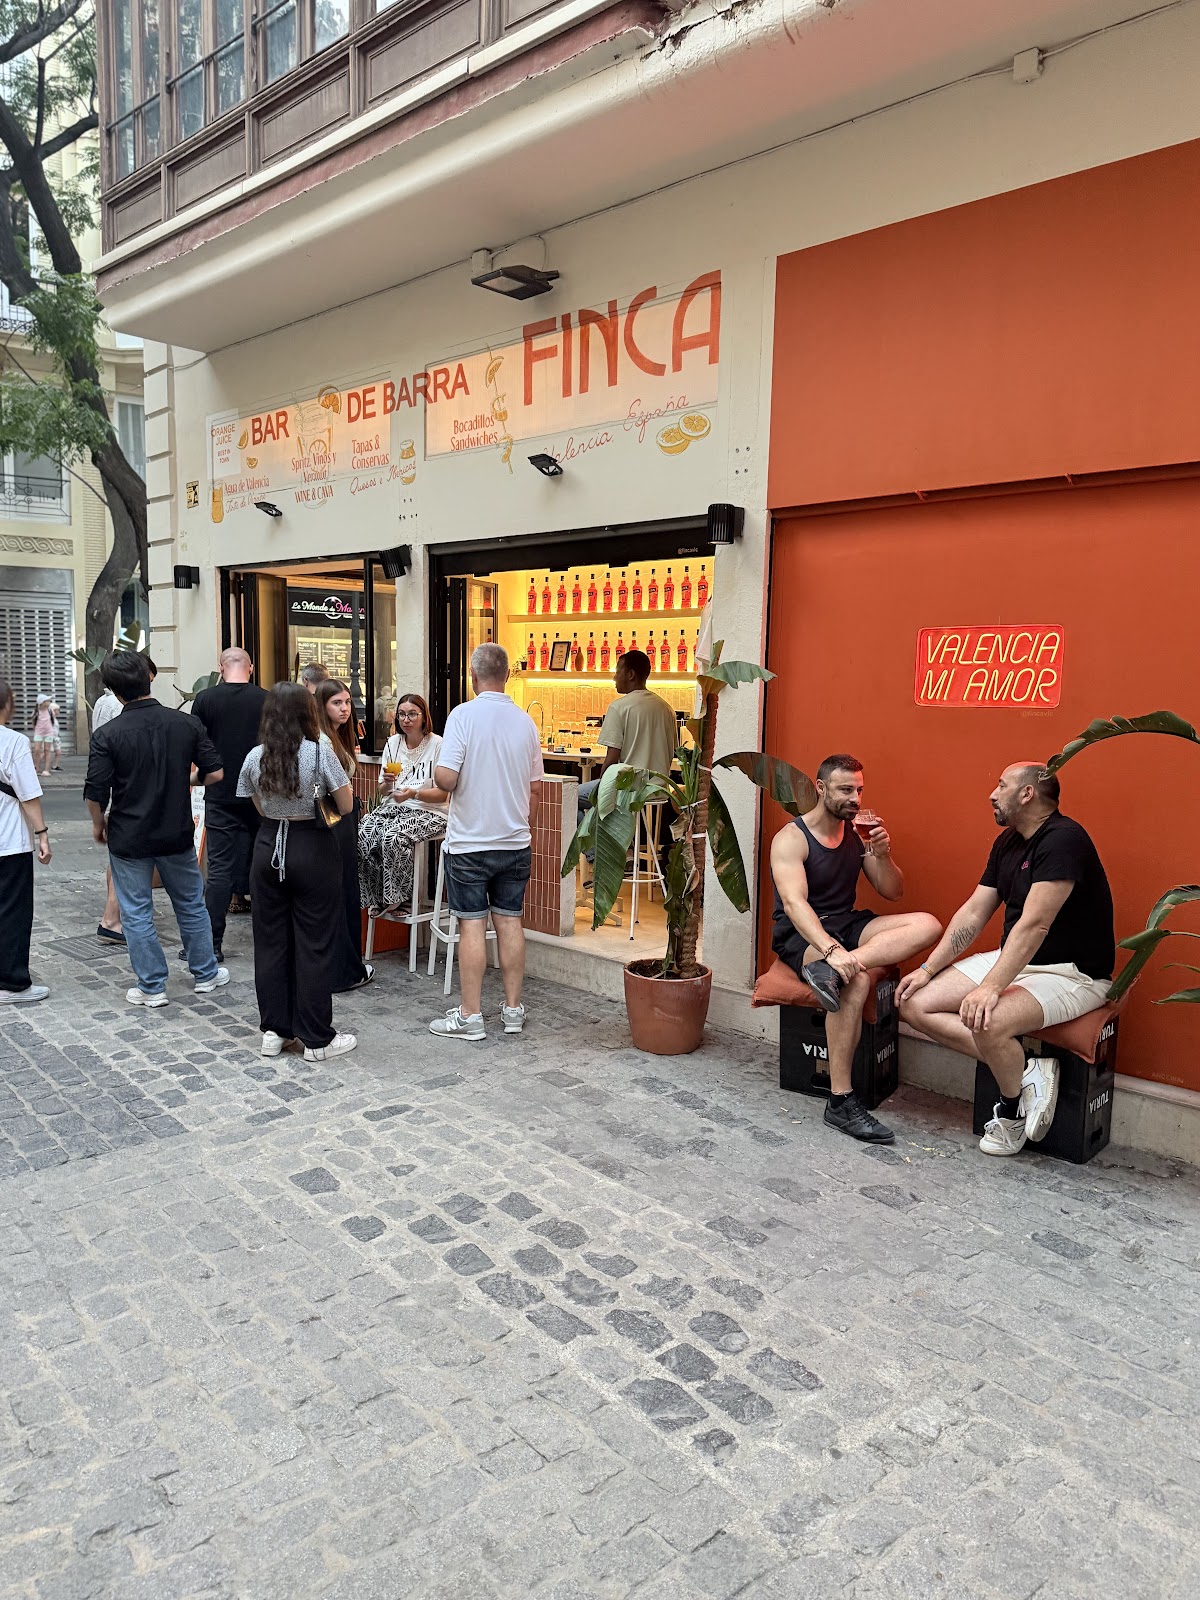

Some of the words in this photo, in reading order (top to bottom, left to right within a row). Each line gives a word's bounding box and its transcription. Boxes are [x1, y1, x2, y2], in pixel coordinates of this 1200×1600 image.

[523, 269, 721, 406] FINCA
[347, 386, 376, 424] DE
[383, 363, 470, 416] BARRA
[251, 410, 290, 446] BAR
[453, 413, 495, 435] Bocadillos
[622, 394, 689, 443] España
[211, 423, 236, 438] ORANGE
[216, 434, 232, 446] JUICE
[450, 431, 499, 451] Sandwiches
[351, 439, 373, 456] Tapas
[374, 434, 380, 451] &
[313, 452, 331, 466] Vinos
[351, 453, 390, 470] Conservas
[224, 482, 238, 496] Agua
[238, 479, 246, 492] de
[245, 475, 270, 491] Valencia
[295, 489, 311, 503] WINE
[311, 487, 317, 501] &
[317, 484, 334, 500] CAVA
[350, 476, 377, 496] Quesos
[301, 600, 329, 612] Monde
[928, 632, 1060, 664] VALENCIA
[920, 668, 955, 700] MI
[963, 667, 1058, 702] AMOR
[1099, 1022, 1115, 1043] TURI
[802, 1042, 828, 1060] RIA
[876, 1041, 895, 1063] TURIA
[1089, 1090, 1109, 1114] TURIA
